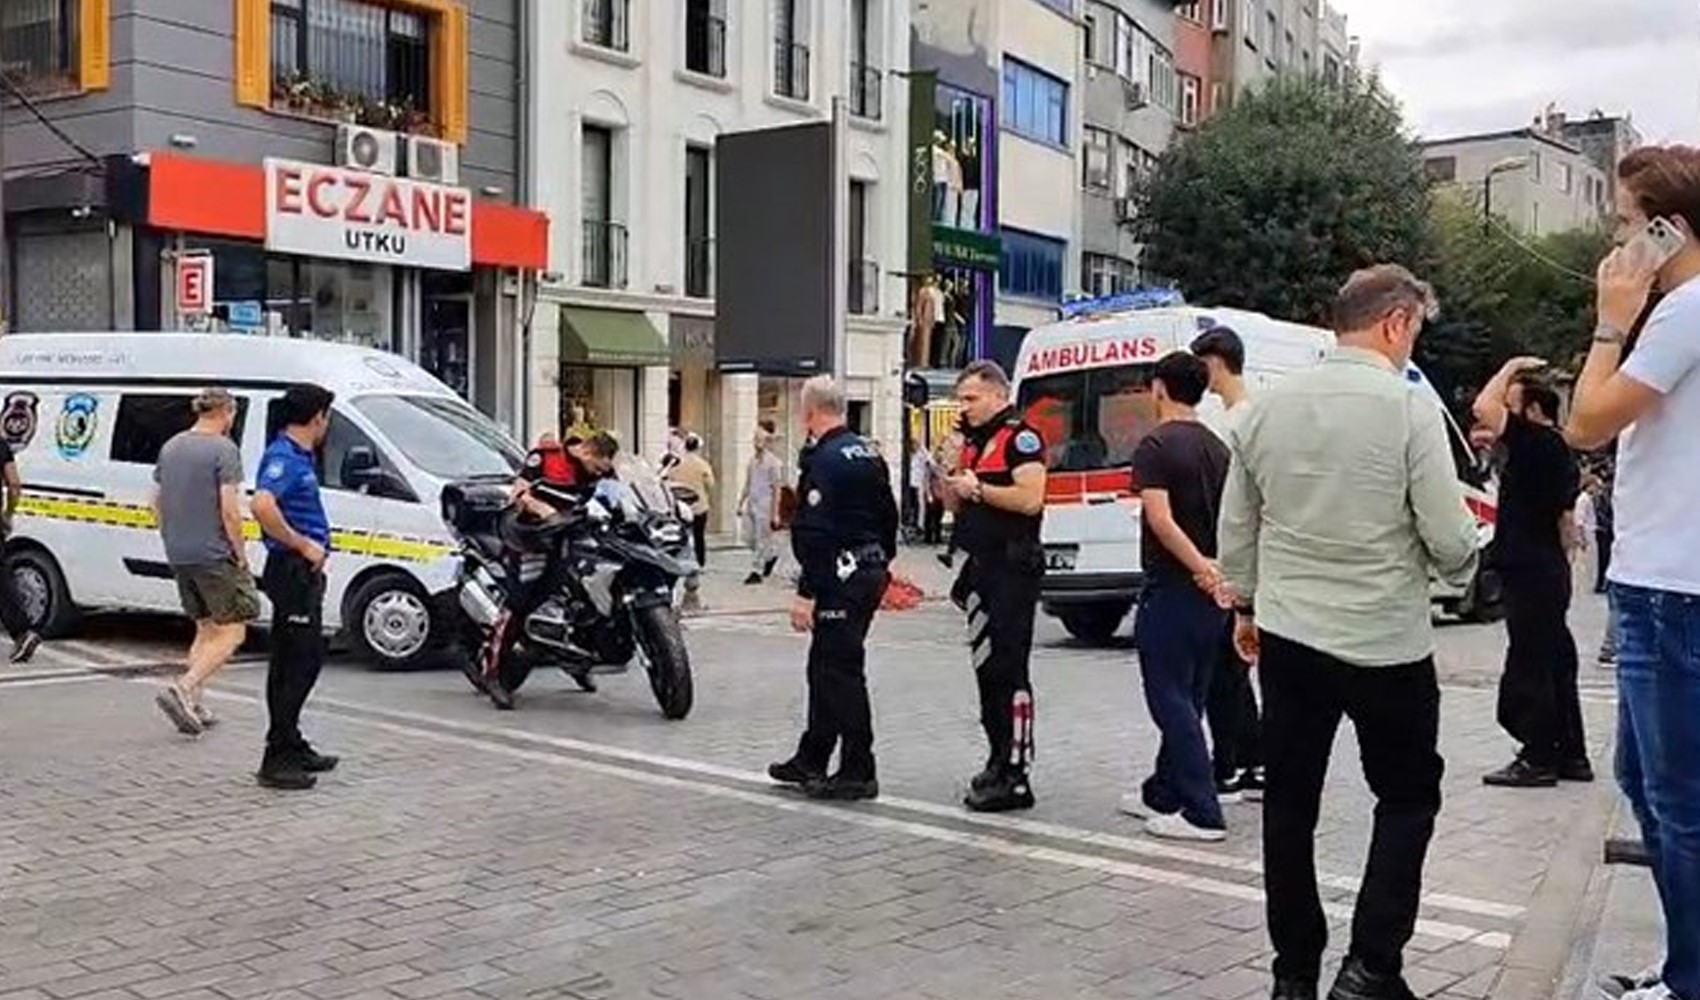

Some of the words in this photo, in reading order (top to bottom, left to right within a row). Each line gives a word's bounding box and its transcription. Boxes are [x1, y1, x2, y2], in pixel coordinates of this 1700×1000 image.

[277, 169, 466, 235] ECZANE
[345, 229, 406, 256] UTKU
[185, 271, 199, 300] E
[1027, 336, 1157, 373] AMBULANS
